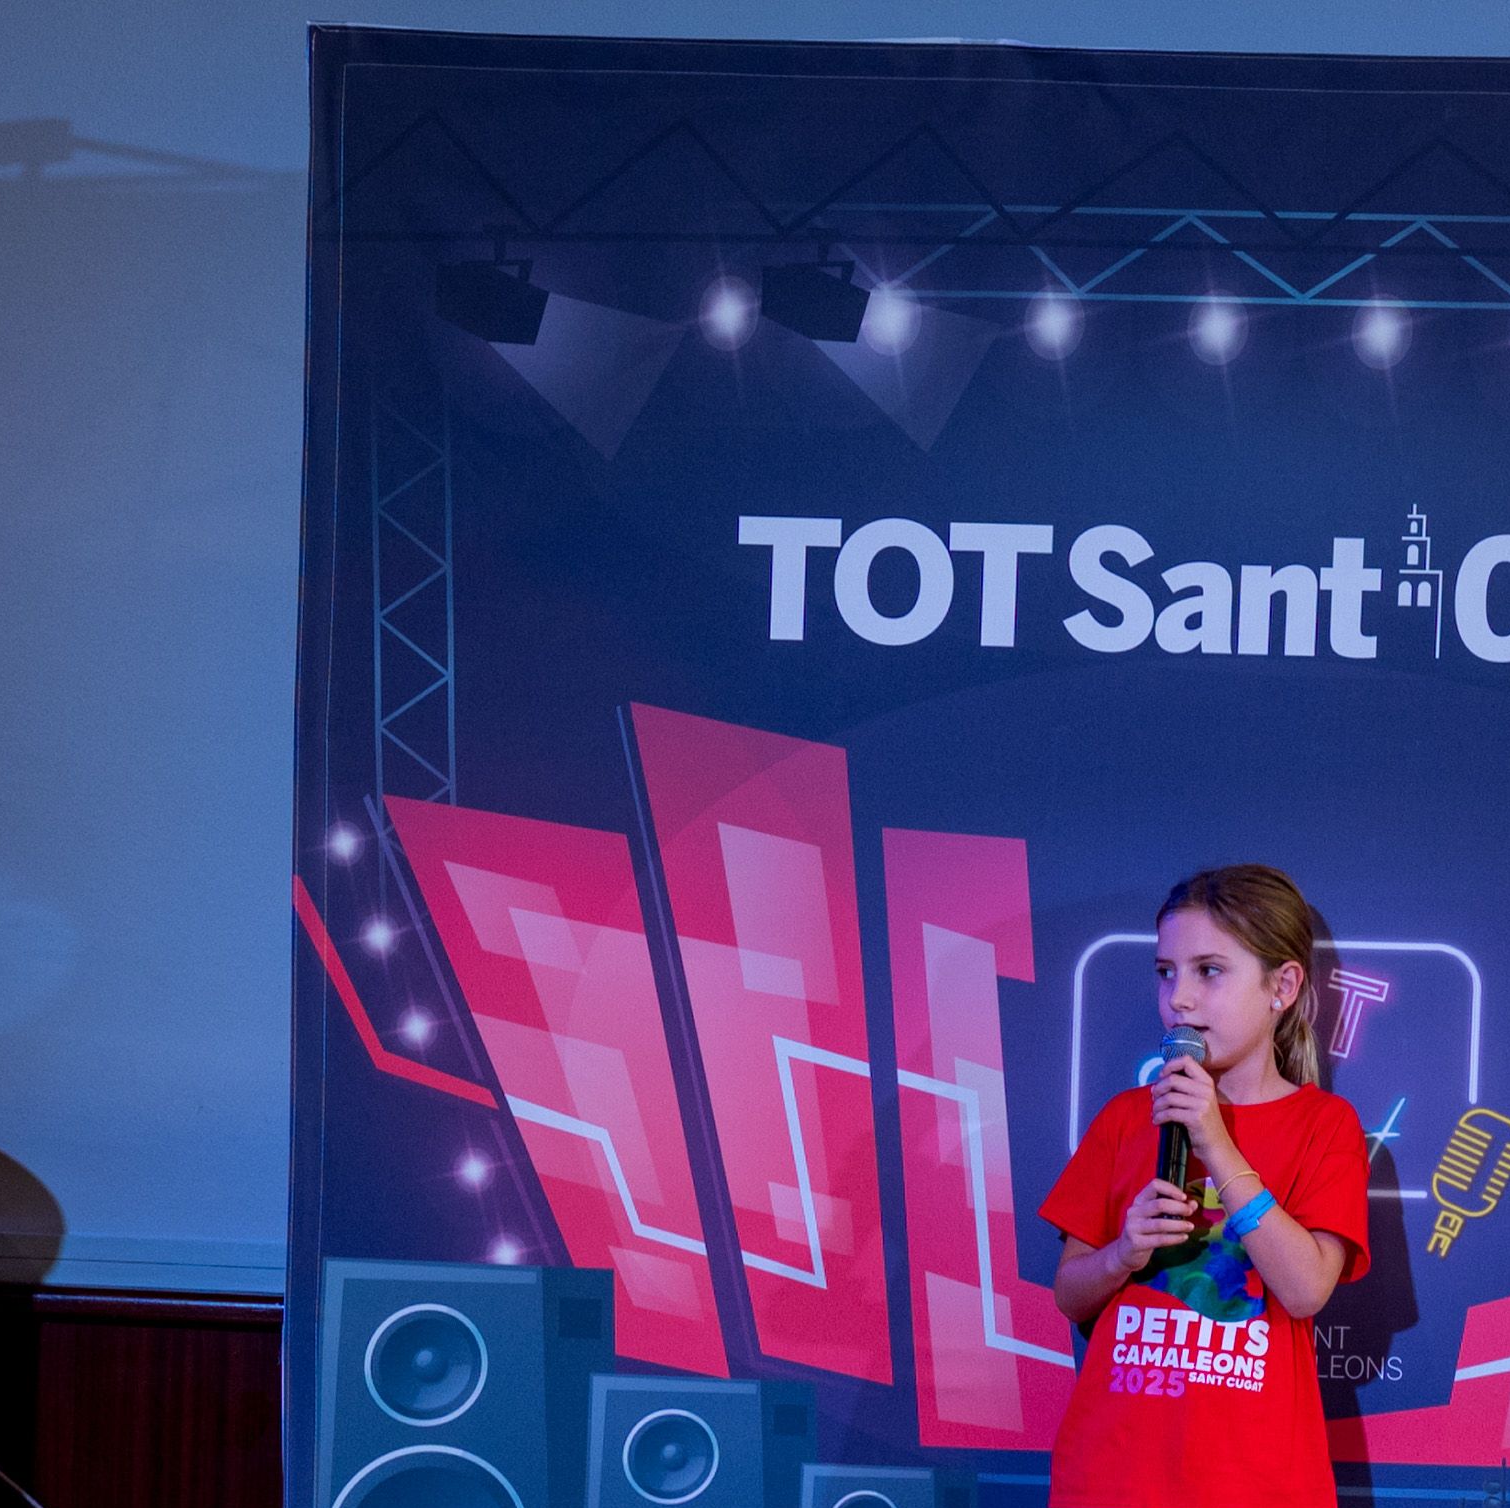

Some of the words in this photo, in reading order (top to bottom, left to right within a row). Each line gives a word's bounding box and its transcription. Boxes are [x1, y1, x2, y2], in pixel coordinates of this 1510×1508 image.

[738, 515, 1054, 647] TOT
[1062, 524, 1382, 659] Sant
[1115, 1305, 1270, 1357] PETITS
[1314, 1325, 1351, 1350] NT
[1112, 1343, 1267, 1381] CAMALEONS
[1315, 1354, 1403, 1381] LEONS
[1109, 1366, 1186, 1398] 2025
[1188, 1371, 1225, 1387] SANT
[1226, 1377, 1264, 1393] CUGAT
